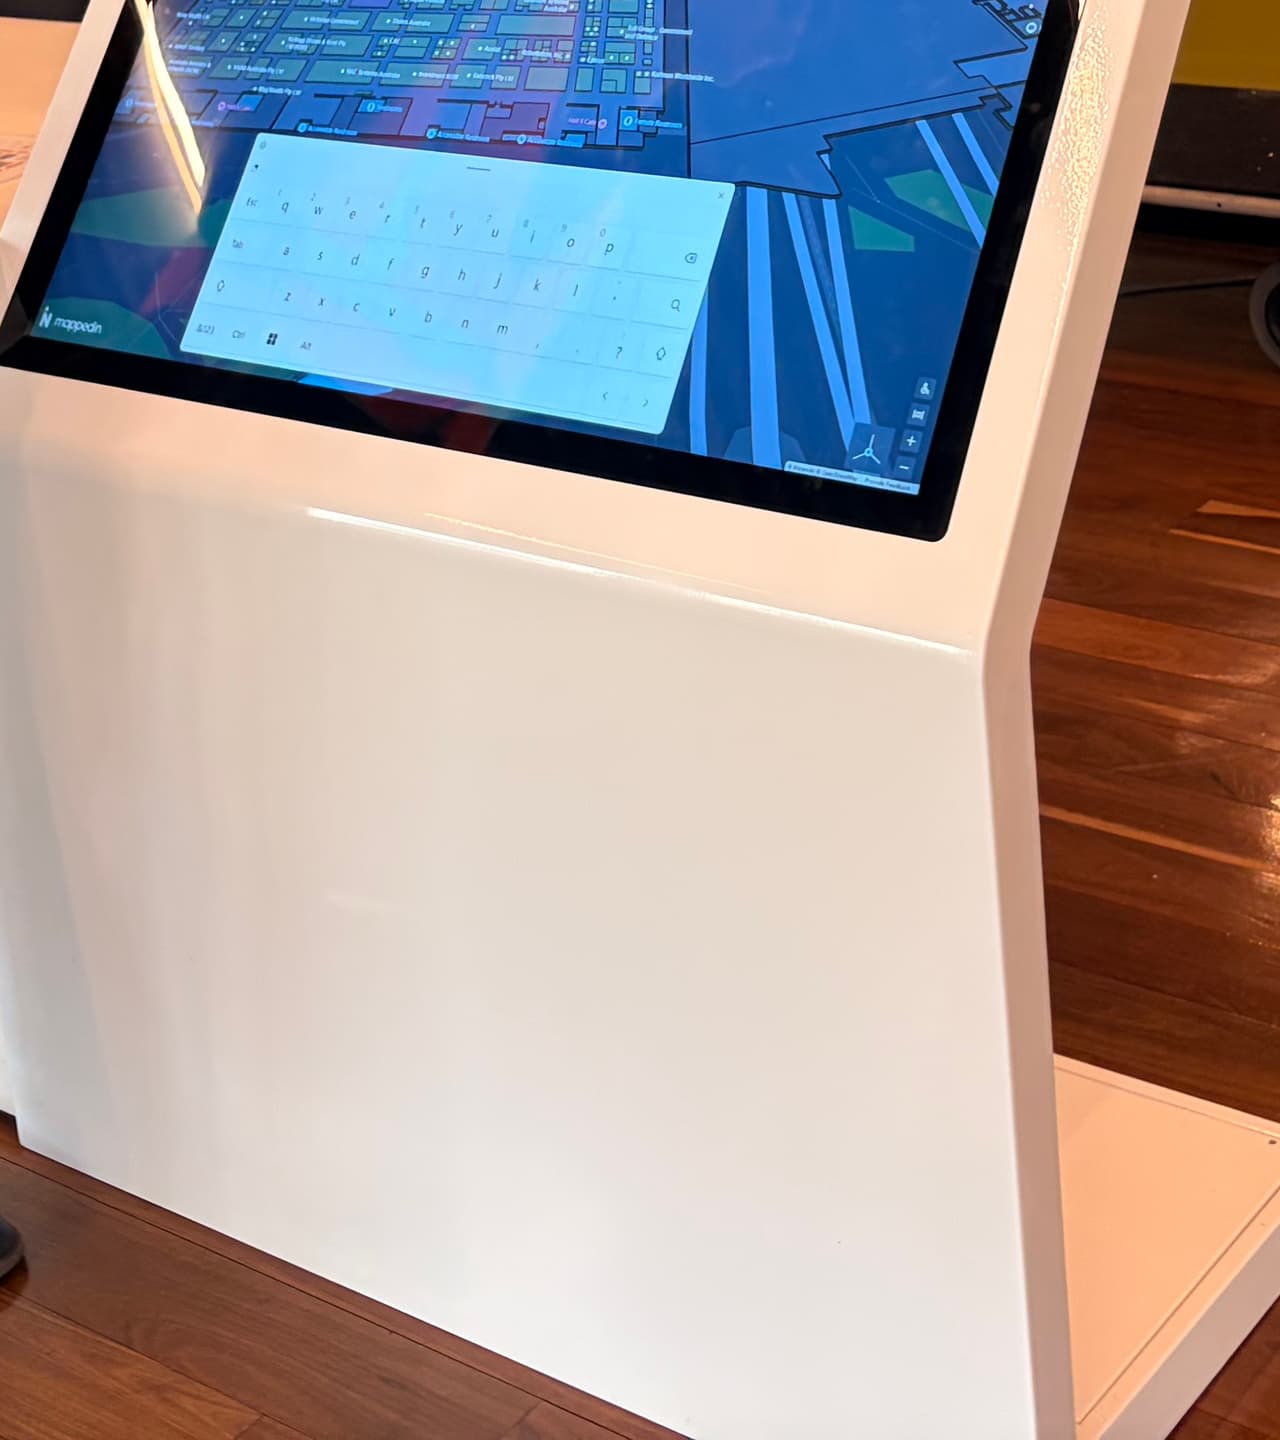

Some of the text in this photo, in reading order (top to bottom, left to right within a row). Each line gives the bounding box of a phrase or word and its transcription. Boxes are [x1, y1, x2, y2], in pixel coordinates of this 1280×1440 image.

[281, 201, 289, 213] q
[314, 205, 323, 215] w
[349, 209, 356, 220] e
[454, 223, 463, 236] y
[491, 228, 499, 238] u
[566, 238, 575, 248] o
[604, 242, 614, 255] p
[351, 254, 360, 266] d
[421, 266, 429, 279] g
[458, 268, 466, 281] h
[533, 279, 541, 291] k
[424, 312, 432, 324] b
[462, 319, 469, 329] n
[54, 317, 102, 334] mappedin
[497, 324, 508, 335] m
